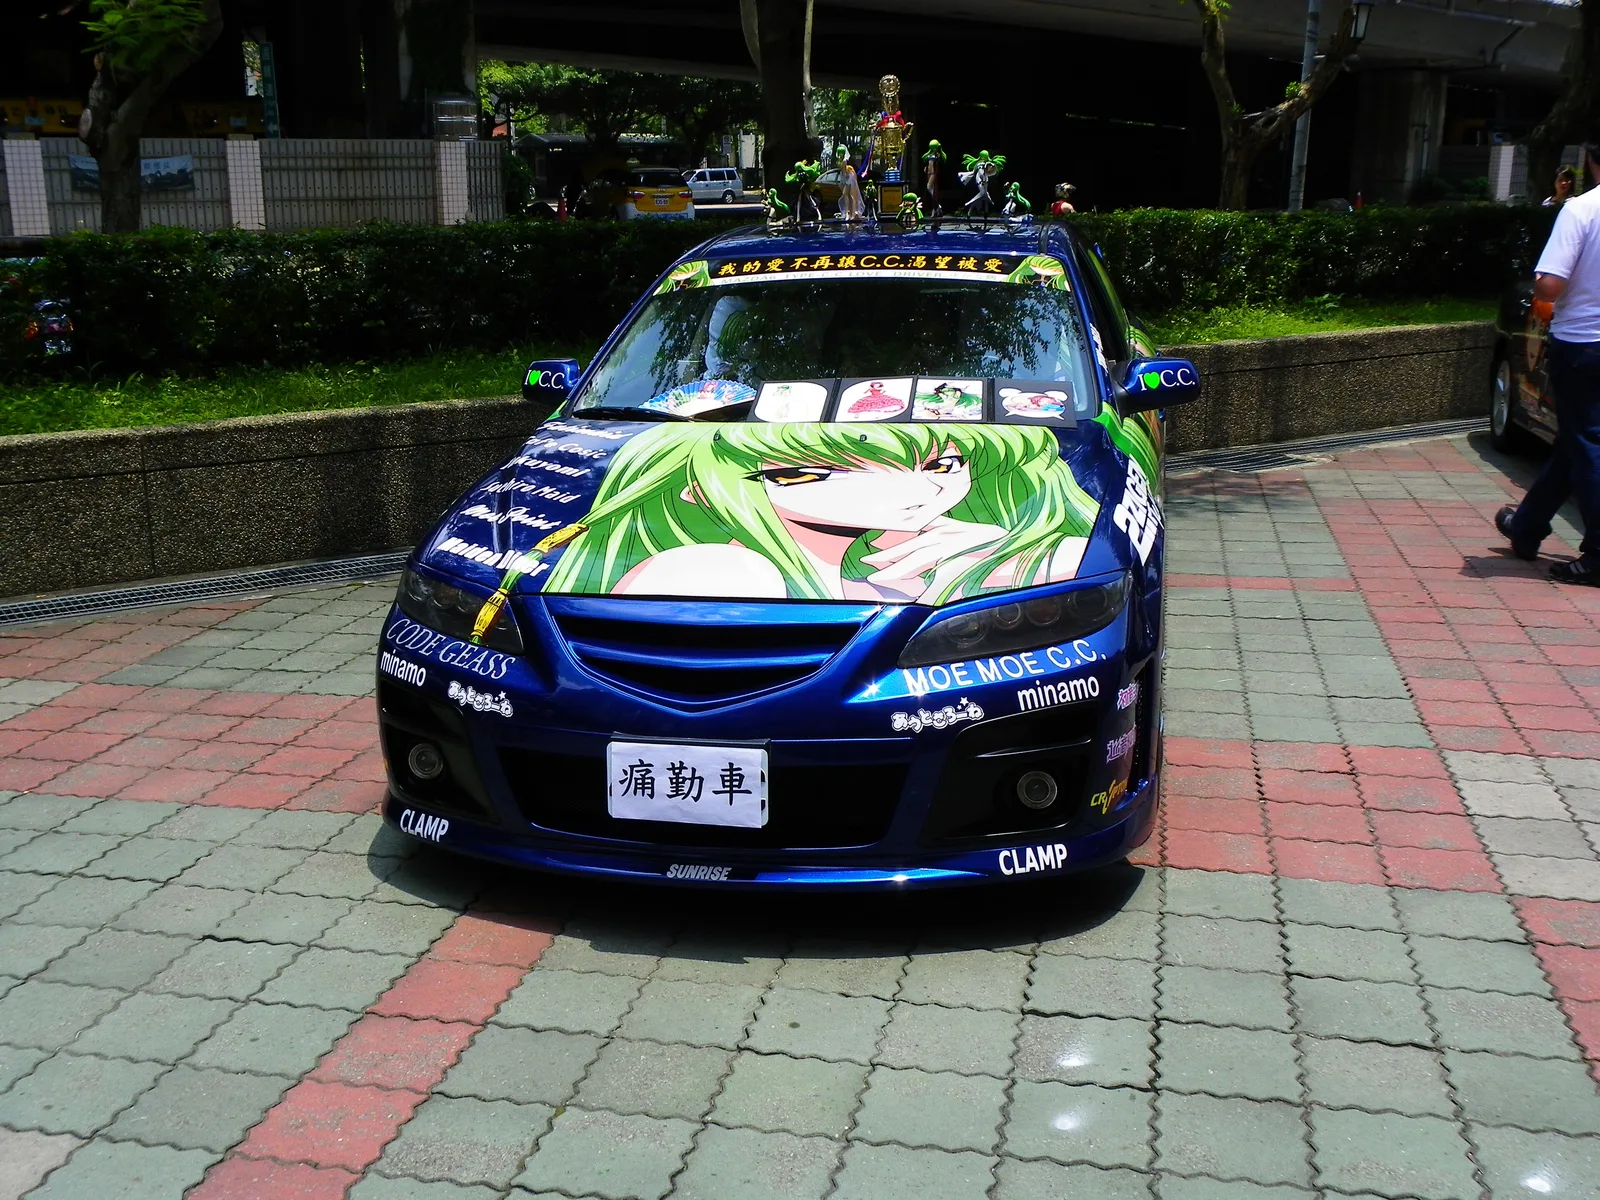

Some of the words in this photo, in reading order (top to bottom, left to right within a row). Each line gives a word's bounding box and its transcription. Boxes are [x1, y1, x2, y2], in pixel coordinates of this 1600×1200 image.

[848, 270, 882, 278] LOVE
[893, 270, 943, 279] DRIVER
[1160, 368, 1196, 388] C.C.
[531, 486, 582, 504] Maid
[437, 537, 503, 567] Maiden
[387, 618, 445, 656] CODE
[439, 641, 516, 680] GEASS
[380, 649, 427, 687] minamo
[903, 662, 974, 696] MOE
[975, 652, 1045, 684] MOE
[1046, 639, 1108, 669] C.C.
[1017, 676, 1100, 711] minamo
[618, 758, 753, 806] 痛勤車
[400, 808, 450, 843] CLAMP
[666, 864, 732, 881] SUNRISE
[998, 843, 1068, 876] CLAMP
